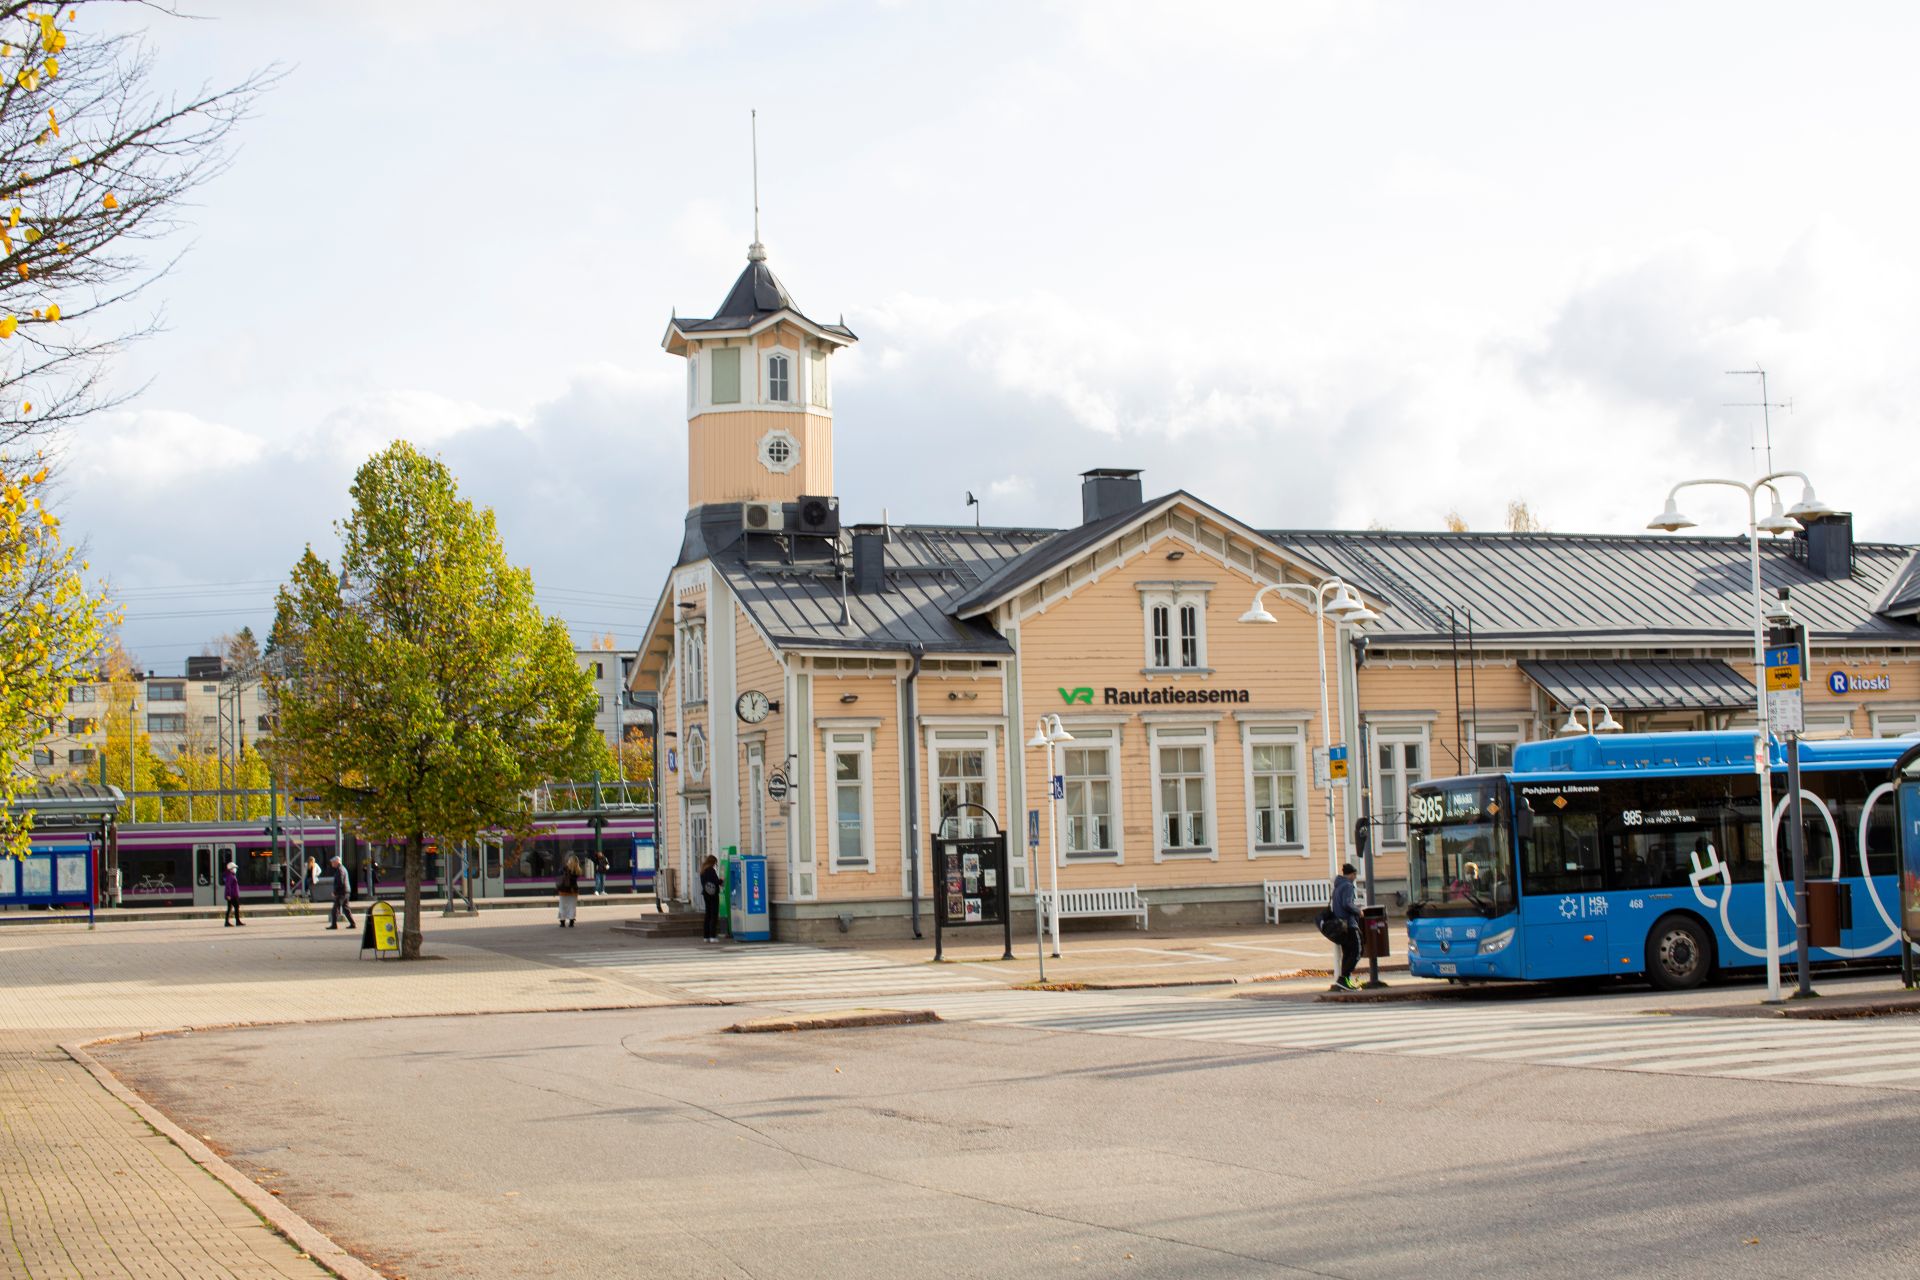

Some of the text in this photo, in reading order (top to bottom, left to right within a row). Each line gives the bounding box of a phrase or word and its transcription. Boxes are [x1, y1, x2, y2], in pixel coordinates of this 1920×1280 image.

[1776, 651, 1788, 665] 12
[1850, 674, 1890, 690] kioski
[1058, 686, 1250, 705] VR Rautatieasema
[1522, 785, 1600, 795] Pohjolan Liikenne
[1419, 795, 1444, 823] 985
[1623, 809, 1643, 826] 985
[1589, 896, 1607, 906] HSL
[1629, 899, 1644, 909] 468
[1590, 904, 1608, 915] HRT
